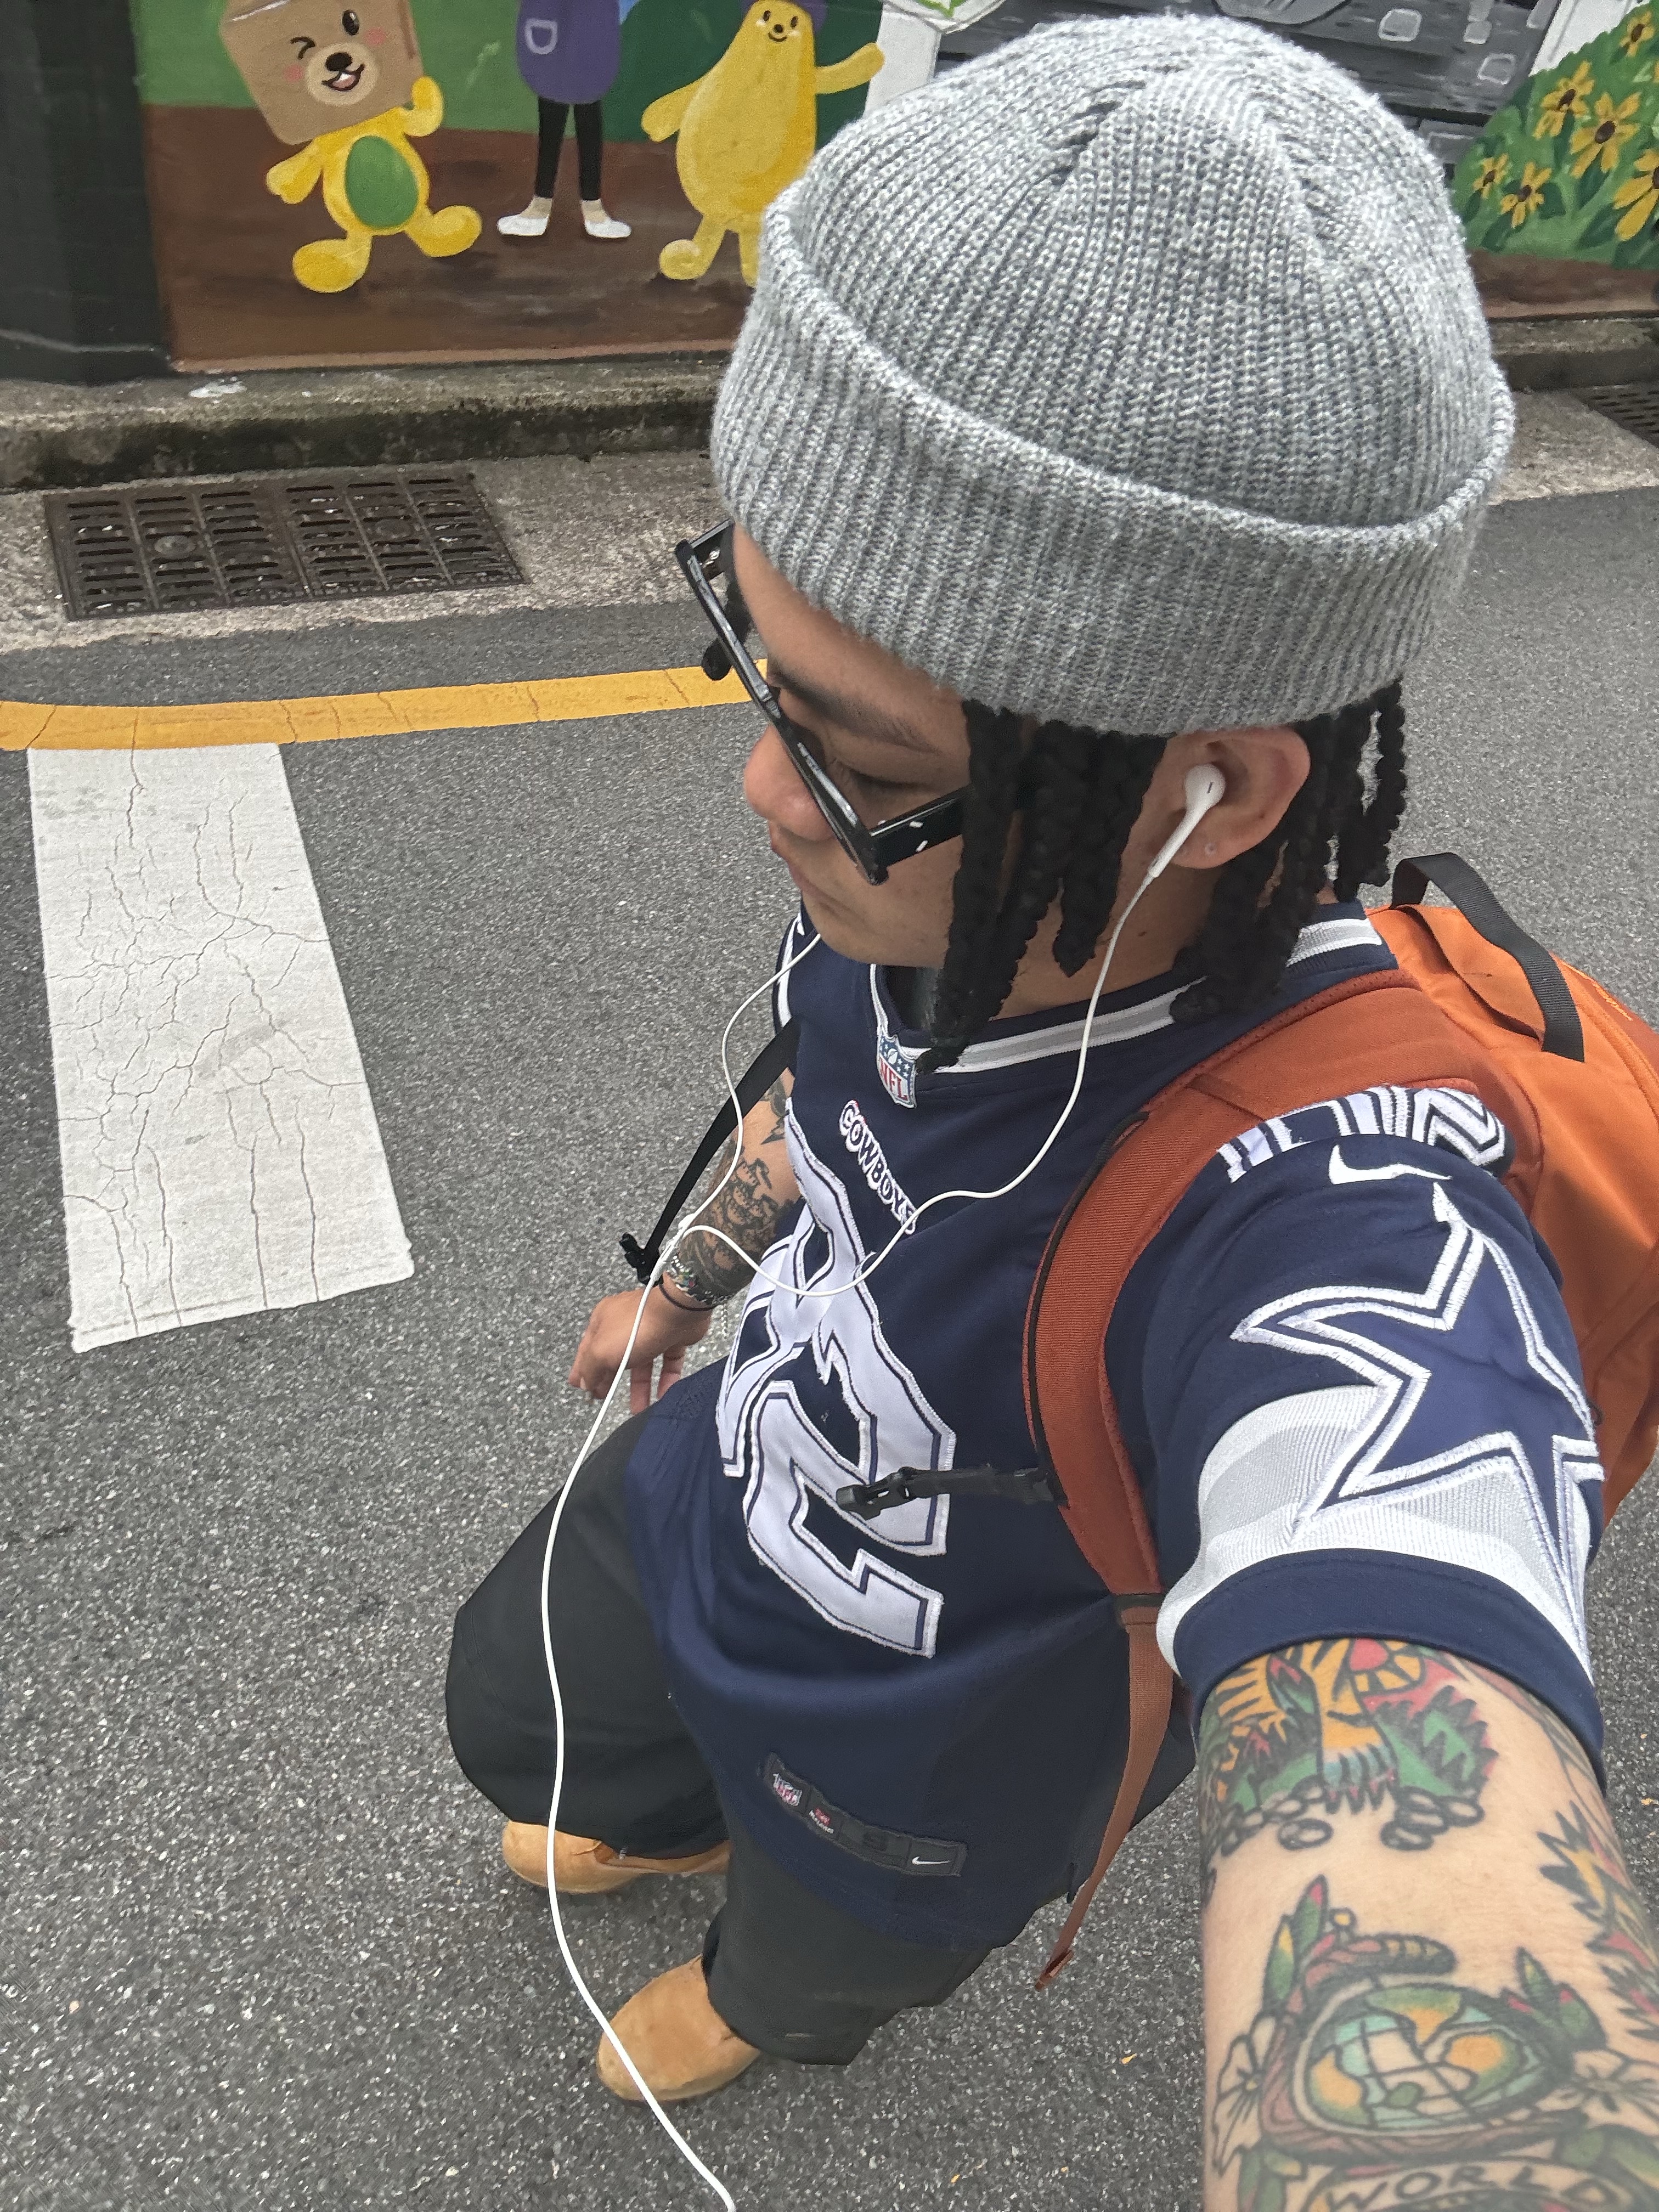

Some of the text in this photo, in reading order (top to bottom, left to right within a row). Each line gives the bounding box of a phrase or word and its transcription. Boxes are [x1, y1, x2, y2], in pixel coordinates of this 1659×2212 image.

[879, 1057, 909, 1101] NFL
[839, 1099, 918, 1235] COWBOYS
[1325, 2165, 1623, 2212] WORLD
